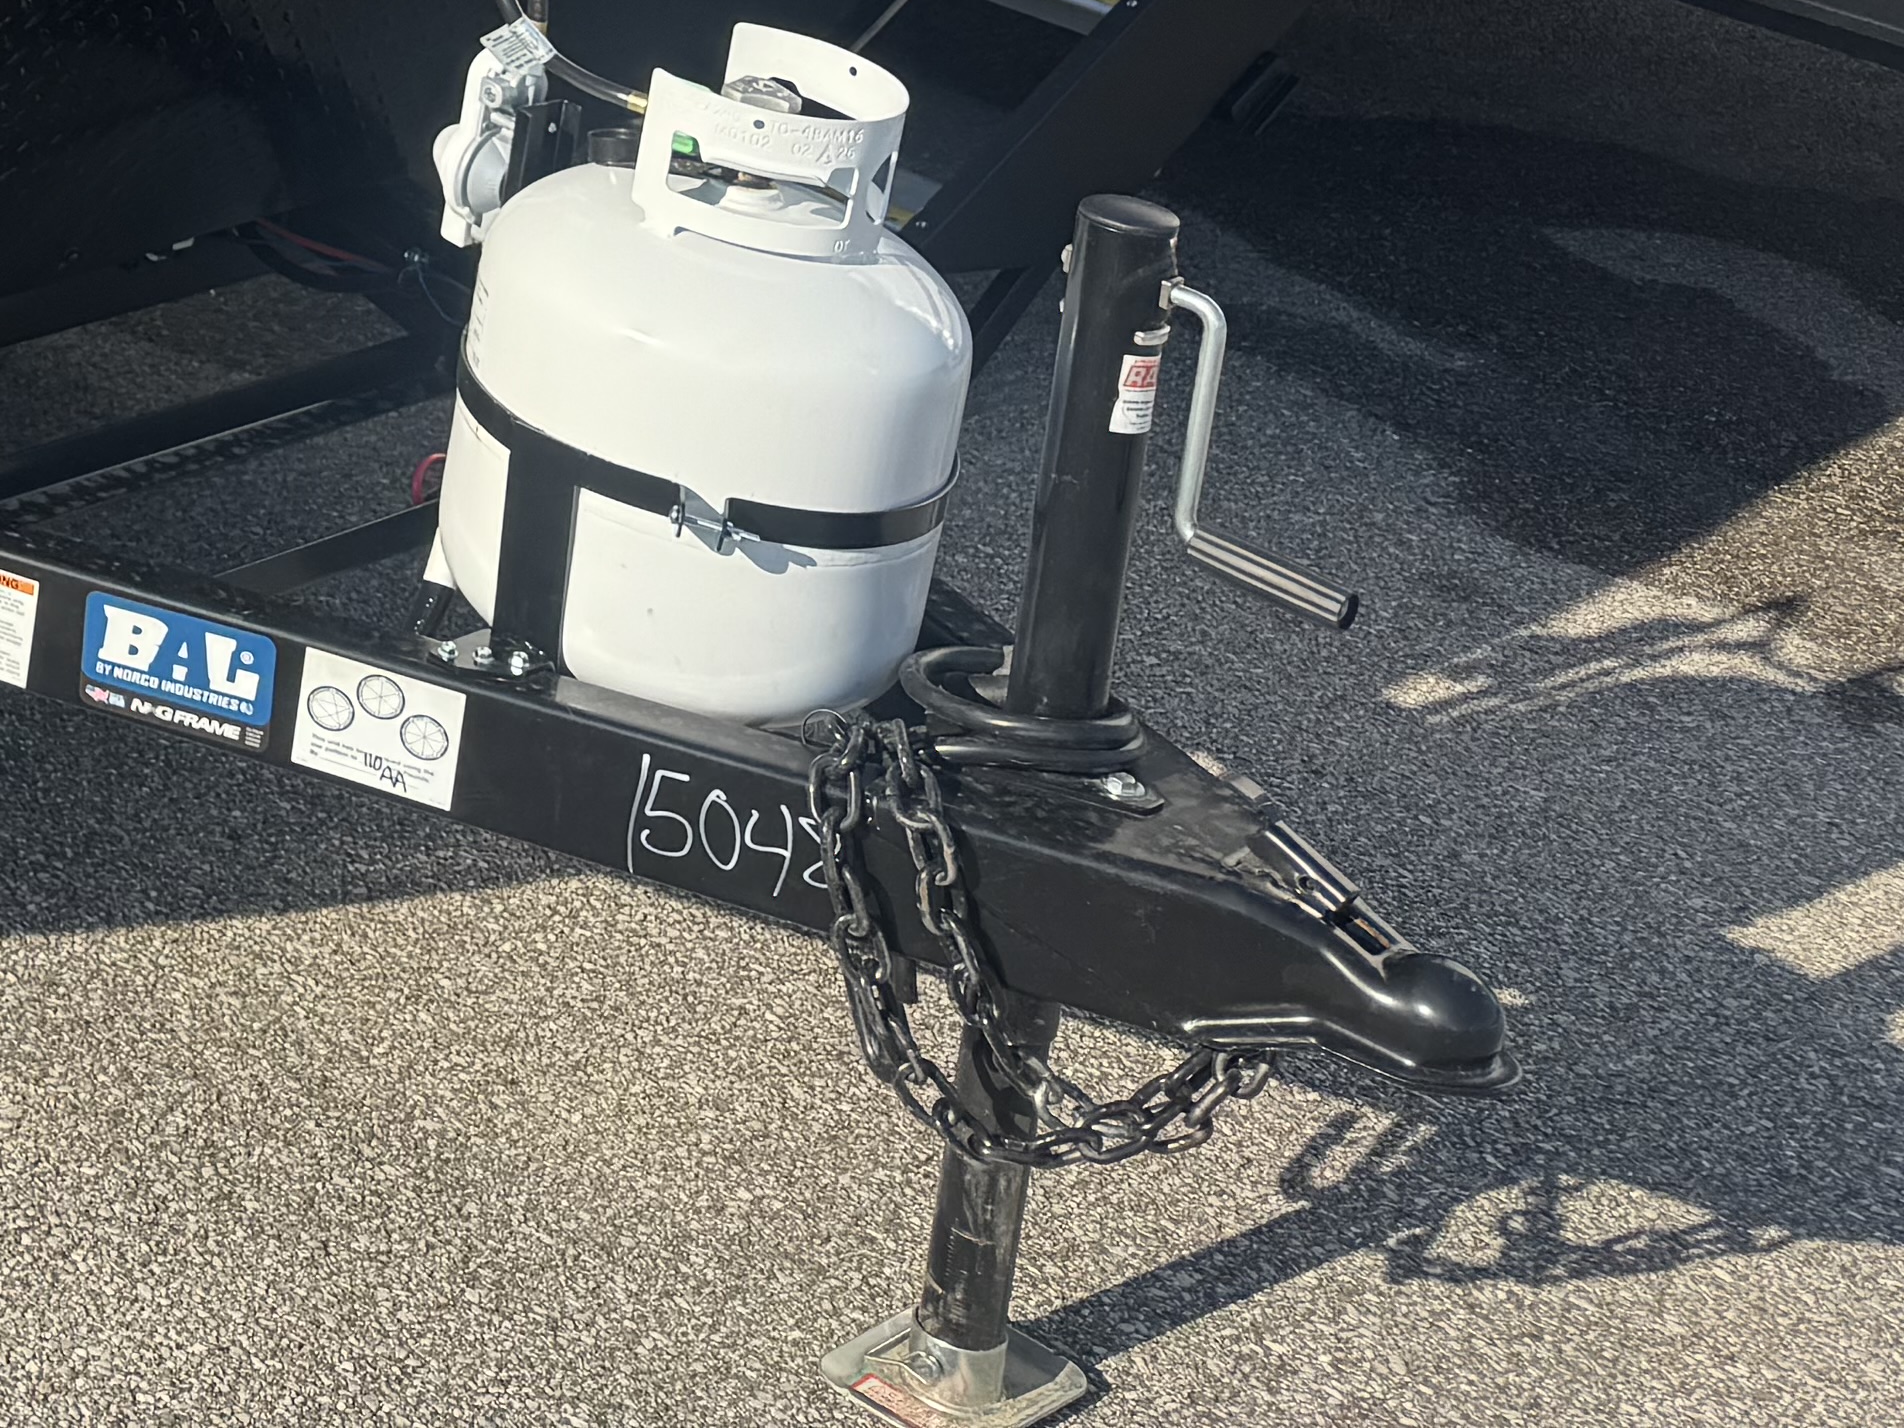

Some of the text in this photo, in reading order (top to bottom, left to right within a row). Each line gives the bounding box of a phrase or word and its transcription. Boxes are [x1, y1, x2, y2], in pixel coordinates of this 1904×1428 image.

[98, 604, 260, 702] BAL
[96, 660, 240, 712] BY NORCO INDUSTRIES
[173, 710, 242, 741] FRAME
